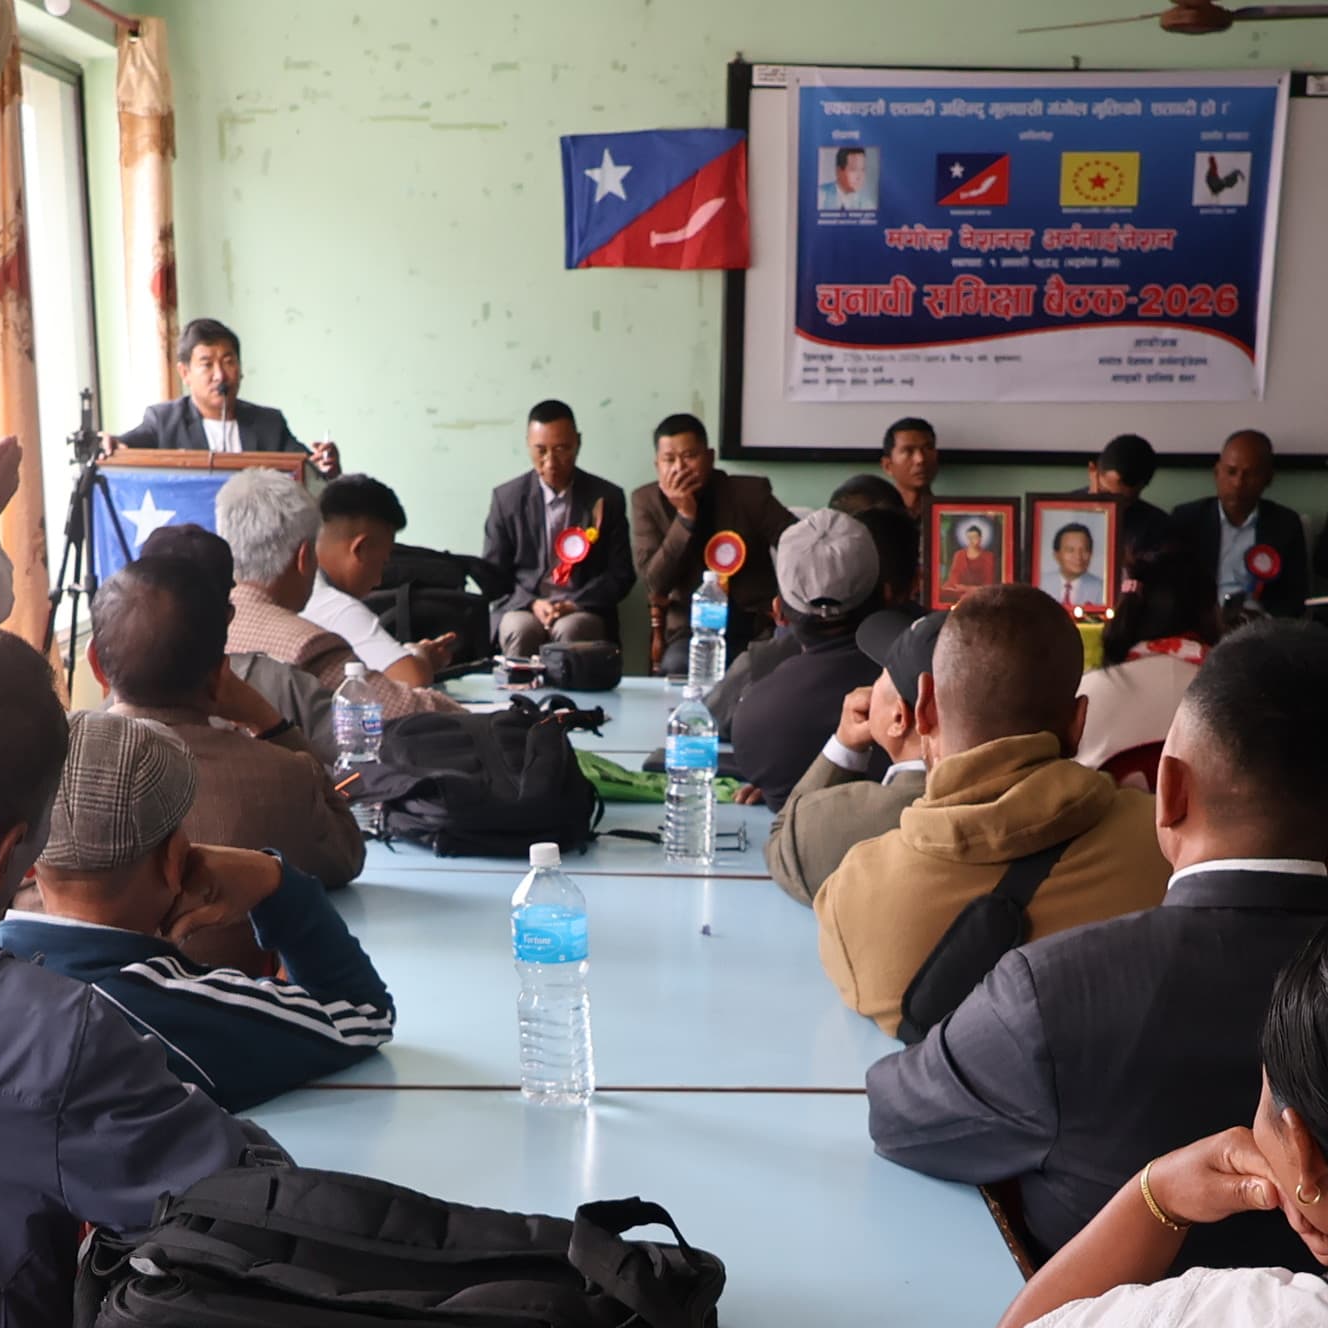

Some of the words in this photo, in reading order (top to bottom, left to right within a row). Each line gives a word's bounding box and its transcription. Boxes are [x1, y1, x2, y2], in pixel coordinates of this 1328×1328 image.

[884, 223, 953, 252] मंगोल
[815, 274, 916, 326] चुनावी
[923, 274, 1037, 321] समिक्षा
[1043, 273, 1239, 318] बैठक-2026
